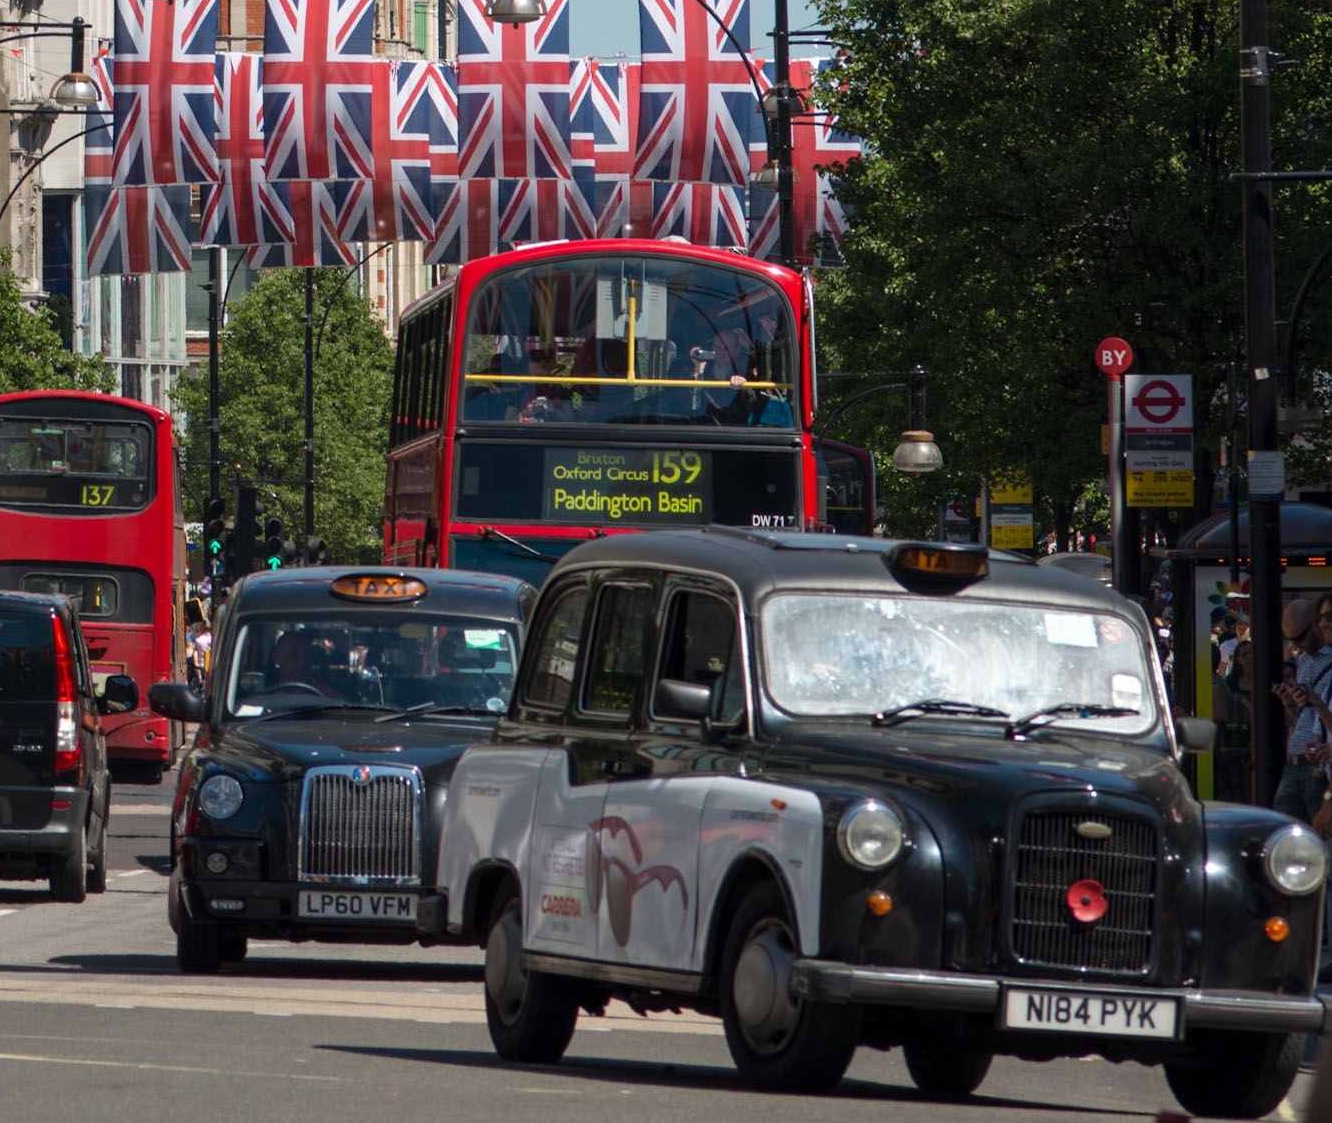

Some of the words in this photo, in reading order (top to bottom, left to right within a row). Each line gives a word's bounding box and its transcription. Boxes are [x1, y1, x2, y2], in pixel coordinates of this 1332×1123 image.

[1102, 350, 1126, 366] BY
[553, 466, 602, 480] Oxford
[607, 467, 649, 481] Circus
[578, 453, 625, 465] Brixton
[652, 451, 702, 484] 159
[82, 486, 115, 506] 137
[554, 489, 653, 519] Paddington
[658, 492, 702, 514] Basin
[752, 515, 771, 527] DW
[773, 516, 785, 527] 71
[351, 579, 408, 595] TAXI
[306, 894, 362, 915] LP60
[370, 895, 410, 916] VFM
[541, 894, 582, 918] CARRERA
[1027, 994, 1091, 1025] N184
[1101, 998, 1158, 1029] PYK
